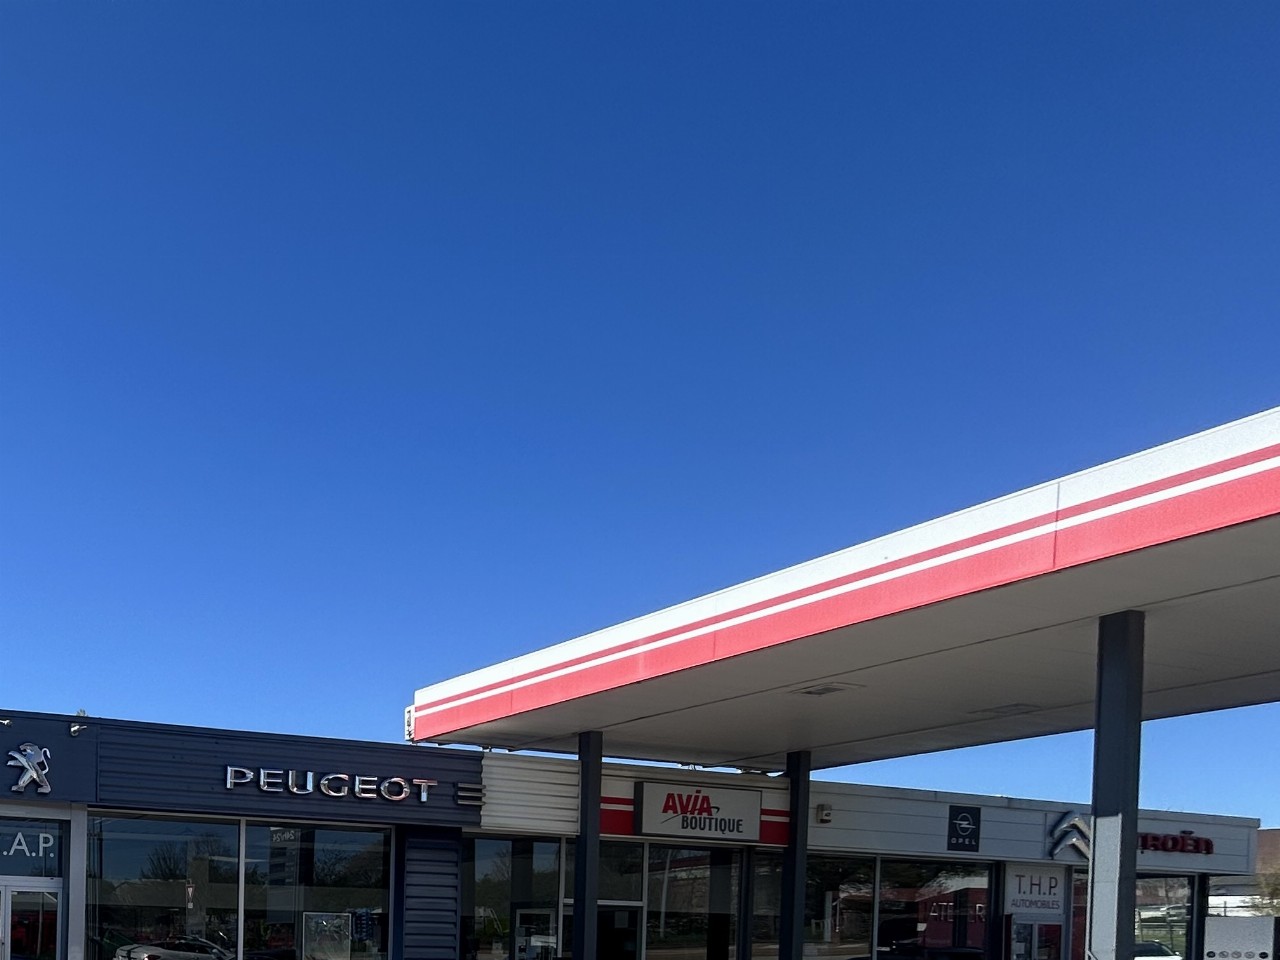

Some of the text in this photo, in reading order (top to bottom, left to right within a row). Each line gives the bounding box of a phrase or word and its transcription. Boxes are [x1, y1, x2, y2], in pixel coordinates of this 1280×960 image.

[226, 765, 438, 802] PEUGEOT
[681, 815, 743, 834] BOUTIQUE
[951, 837, 977, 845] OPEL
[1015, 874, 1059, 896] T.H.P.
[1011, 898, 1061, 909] AUTOMOBILES
